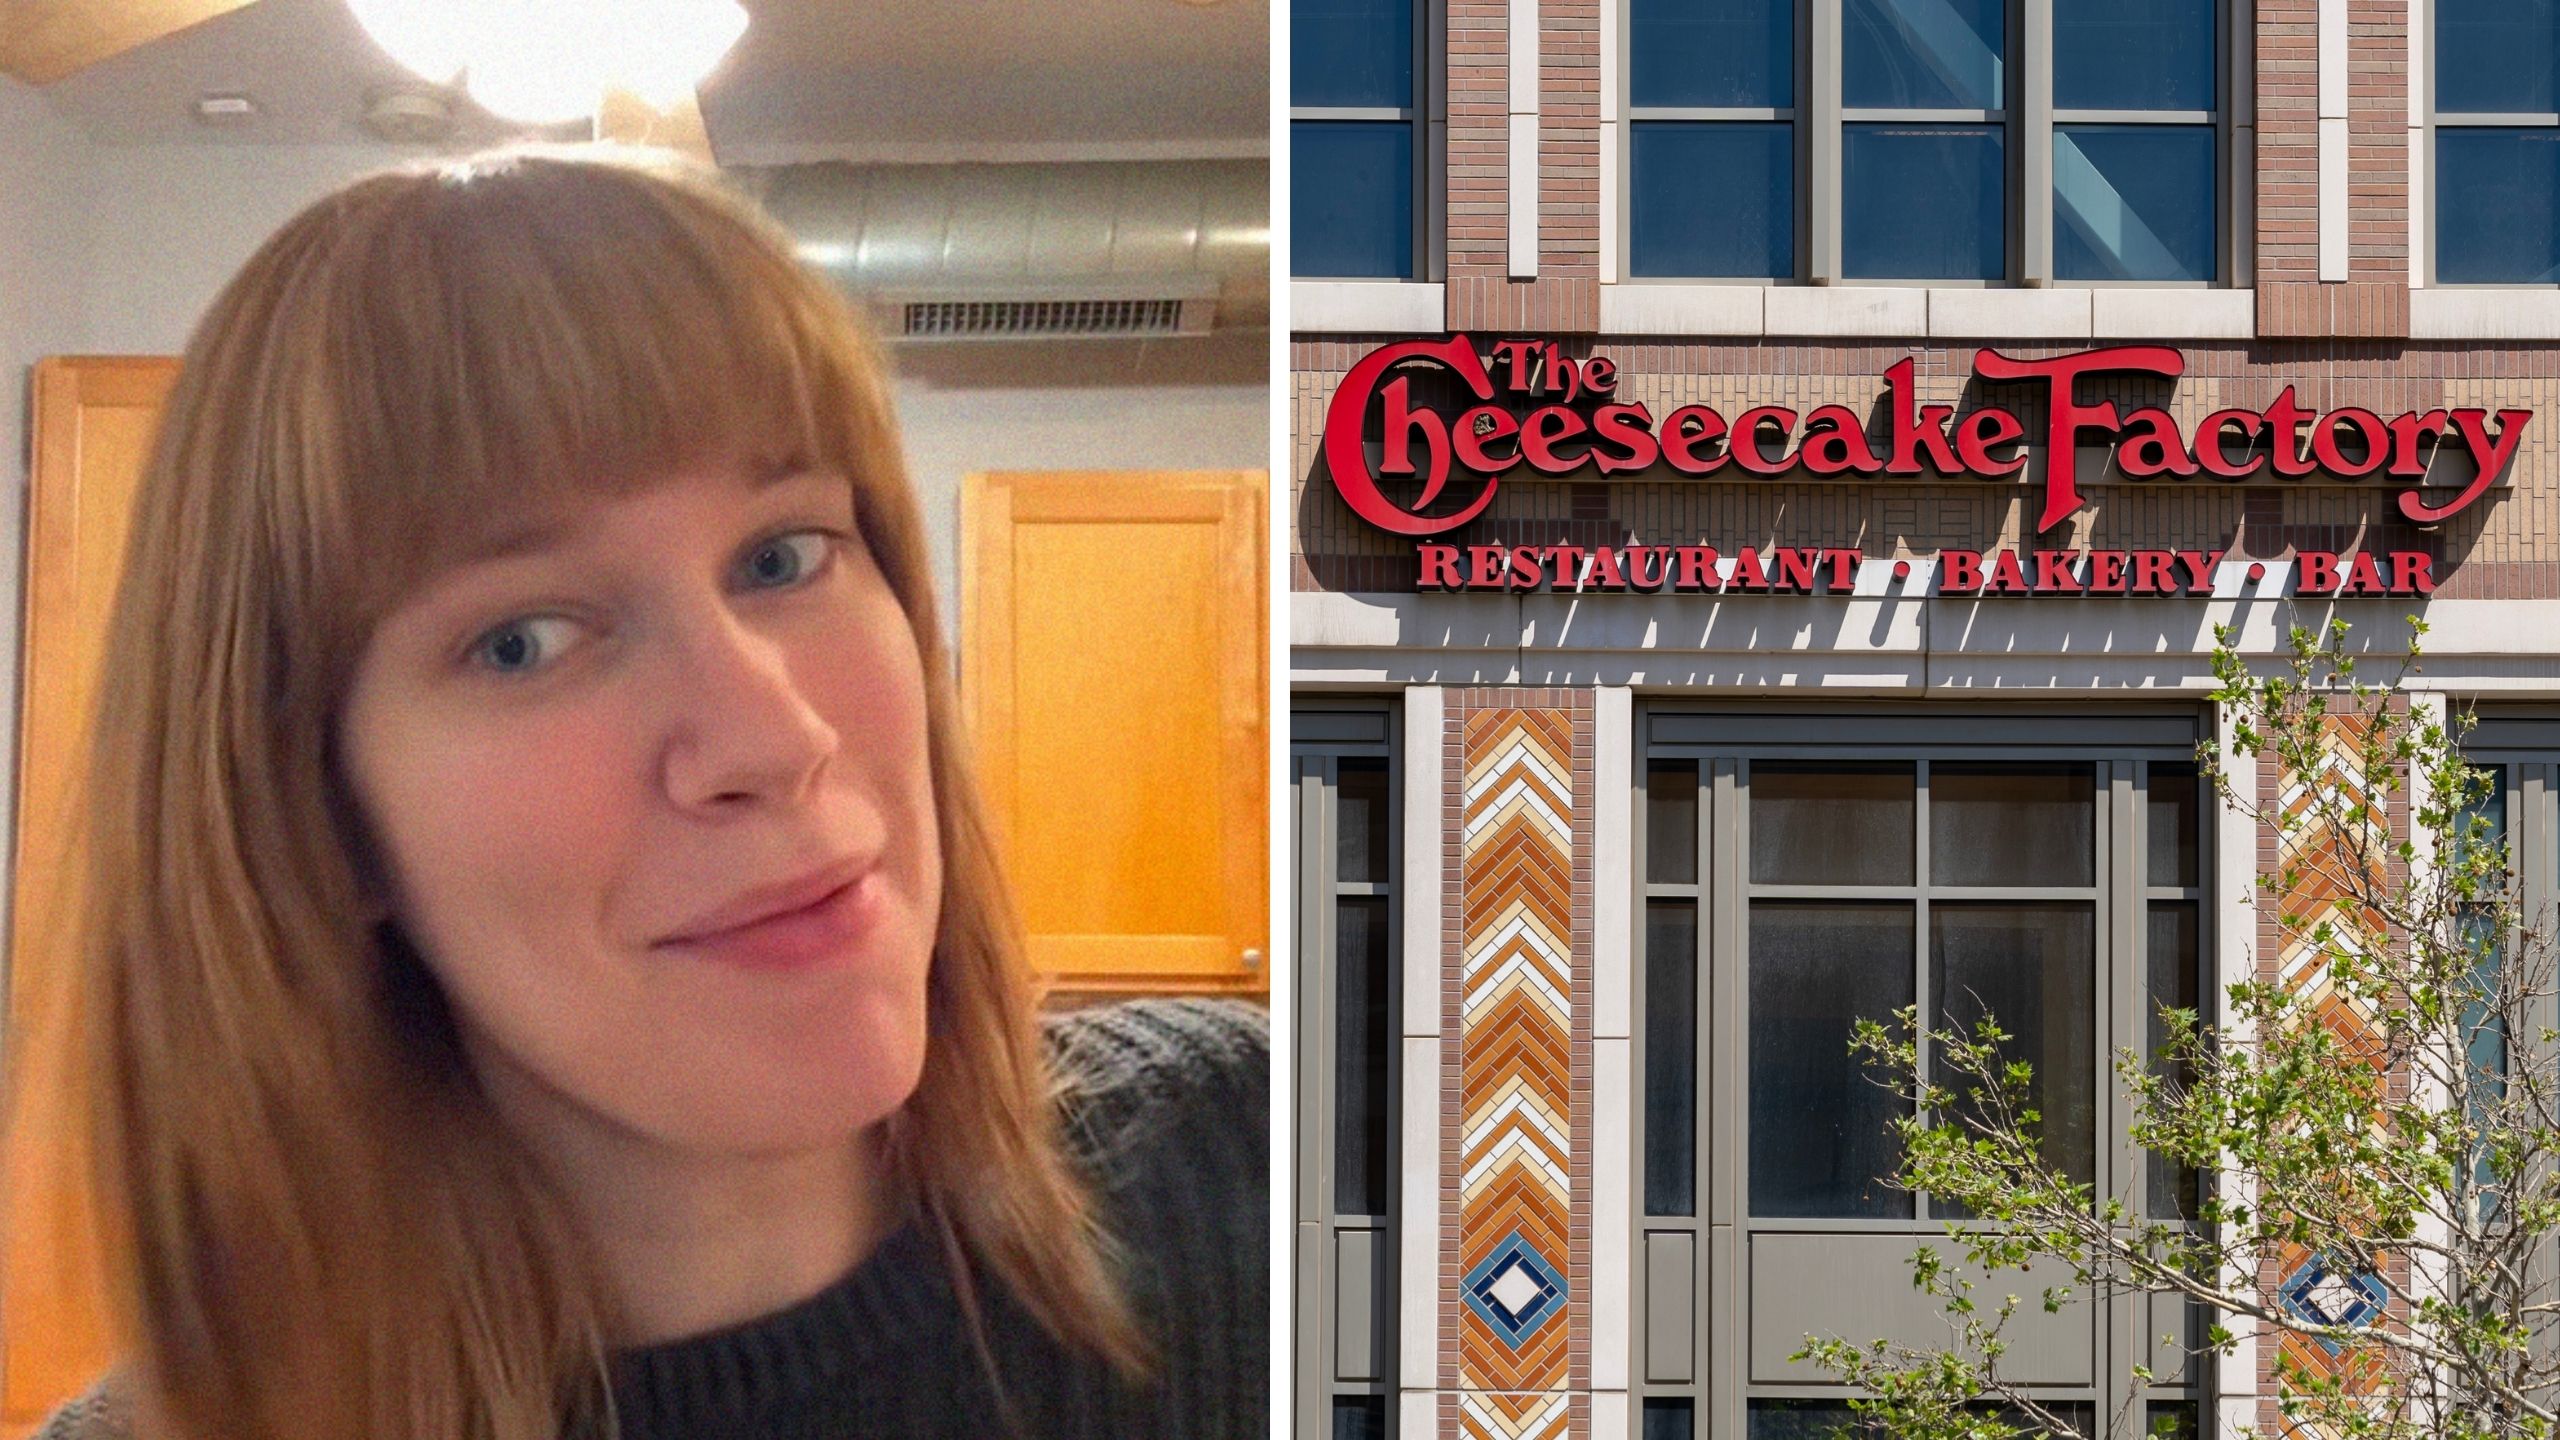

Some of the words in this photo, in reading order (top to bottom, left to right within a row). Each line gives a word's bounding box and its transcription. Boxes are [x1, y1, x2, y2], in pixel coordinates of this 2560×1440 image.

[1492, 340, 1618, 403] The
[1324, 334, 2028, 535] Cheesecake
[1974, 345, 2534, 534] Factory
[1416, 543, 1862, 594] RESTAURANT
[1940, 549, 2225, 597] BAKERY
[2296, 551, 2438, 597] BAR
